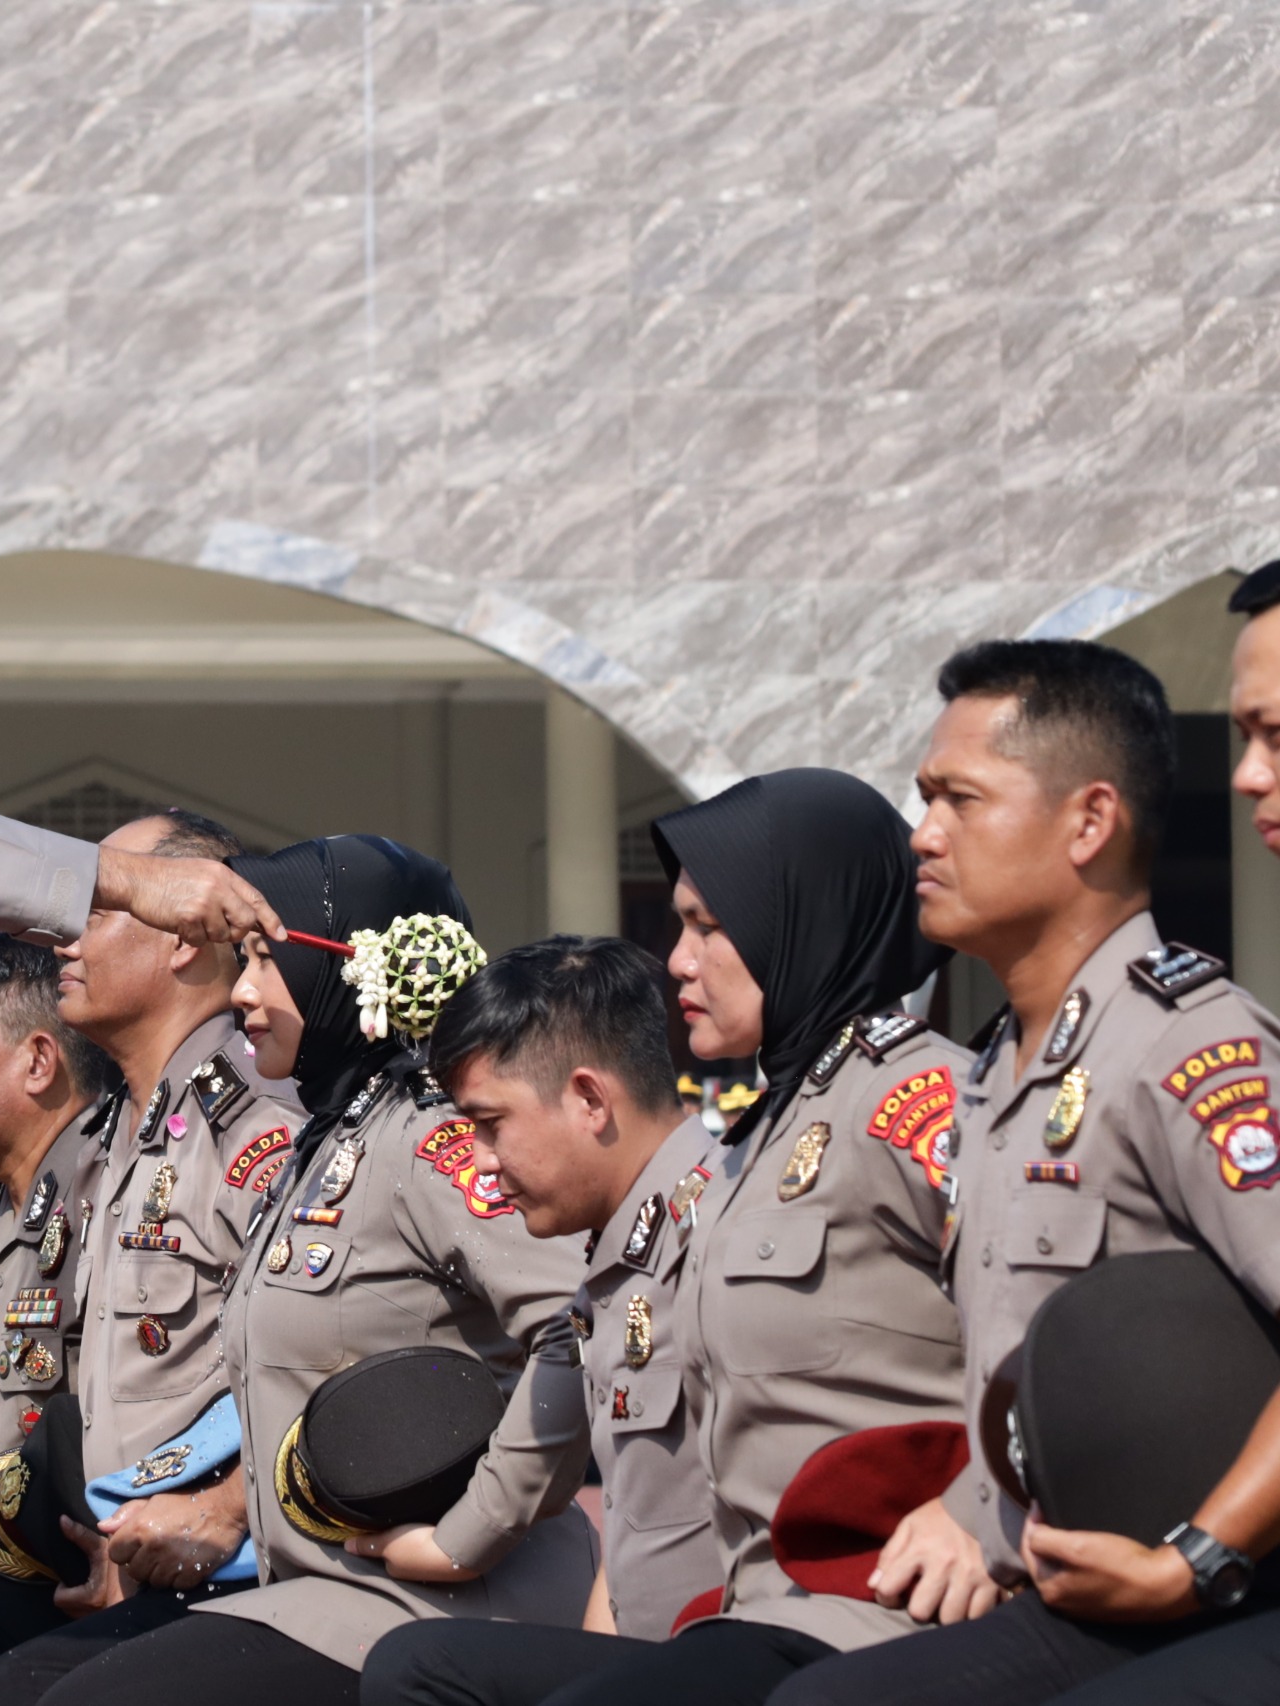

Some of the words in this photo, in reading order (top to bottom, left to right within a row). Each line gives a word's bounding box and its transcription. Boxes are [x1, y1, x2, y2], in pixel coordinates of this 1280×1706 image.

[1170, 1041, 1256, 1092] POLDA
[875, 1071, 944, 1129] POLDA
[898, 1093, 950, 1139] BANTEN
[1196, 1080, 1266, 1118] BANTEN
[232, 1131, 284, 1179] POLDA
[256, 1157, 287, 1187] BANTE
[443, 1144, 473, 1168] BANT
